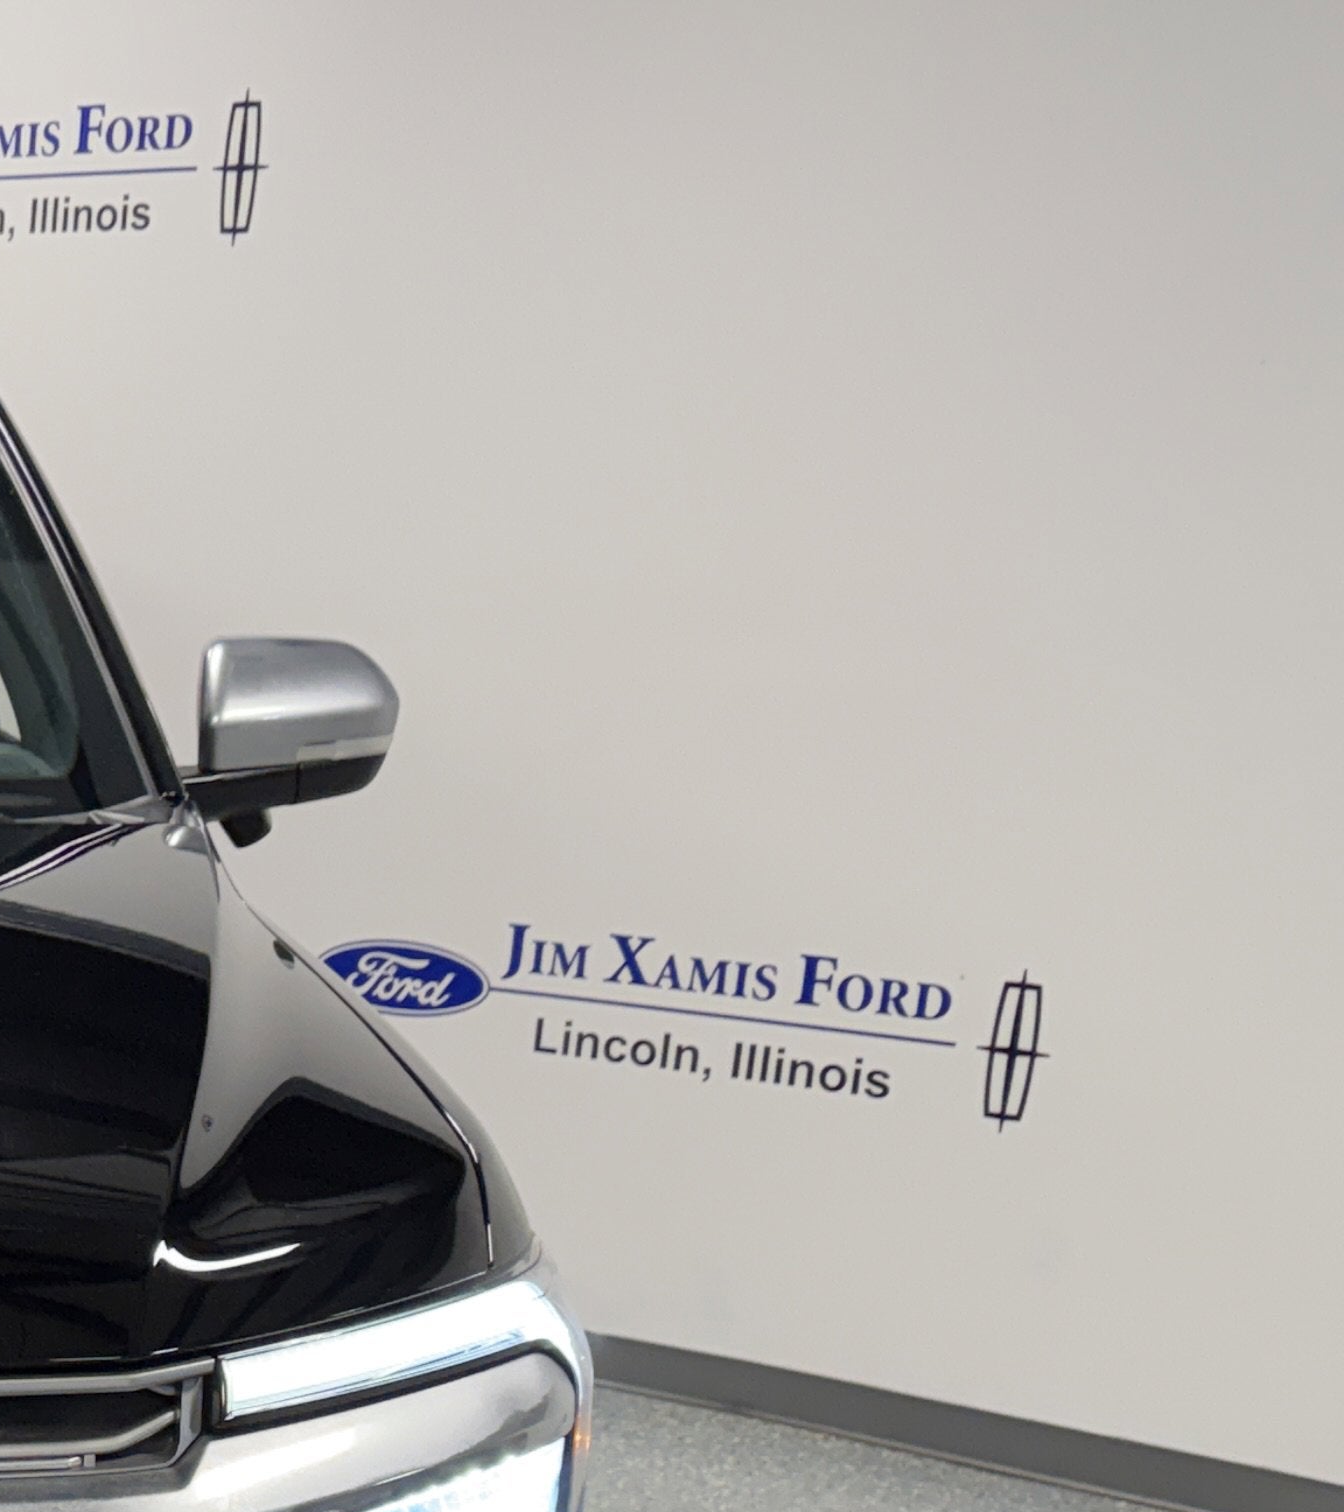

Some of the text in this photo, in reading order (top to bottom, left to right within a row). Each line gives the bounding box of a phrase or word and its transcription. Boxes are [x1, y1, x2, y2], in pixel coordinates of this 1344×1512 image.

[74, 104, 193, 155] FORD
[29, 194, 151, 234] Illinois
[345, 951, 455, 1007] Ford
[502, 924, 953, 1023] JIM XAMIS FORD
[533, 1017, 892, 1100] Lincoln, Illinois
